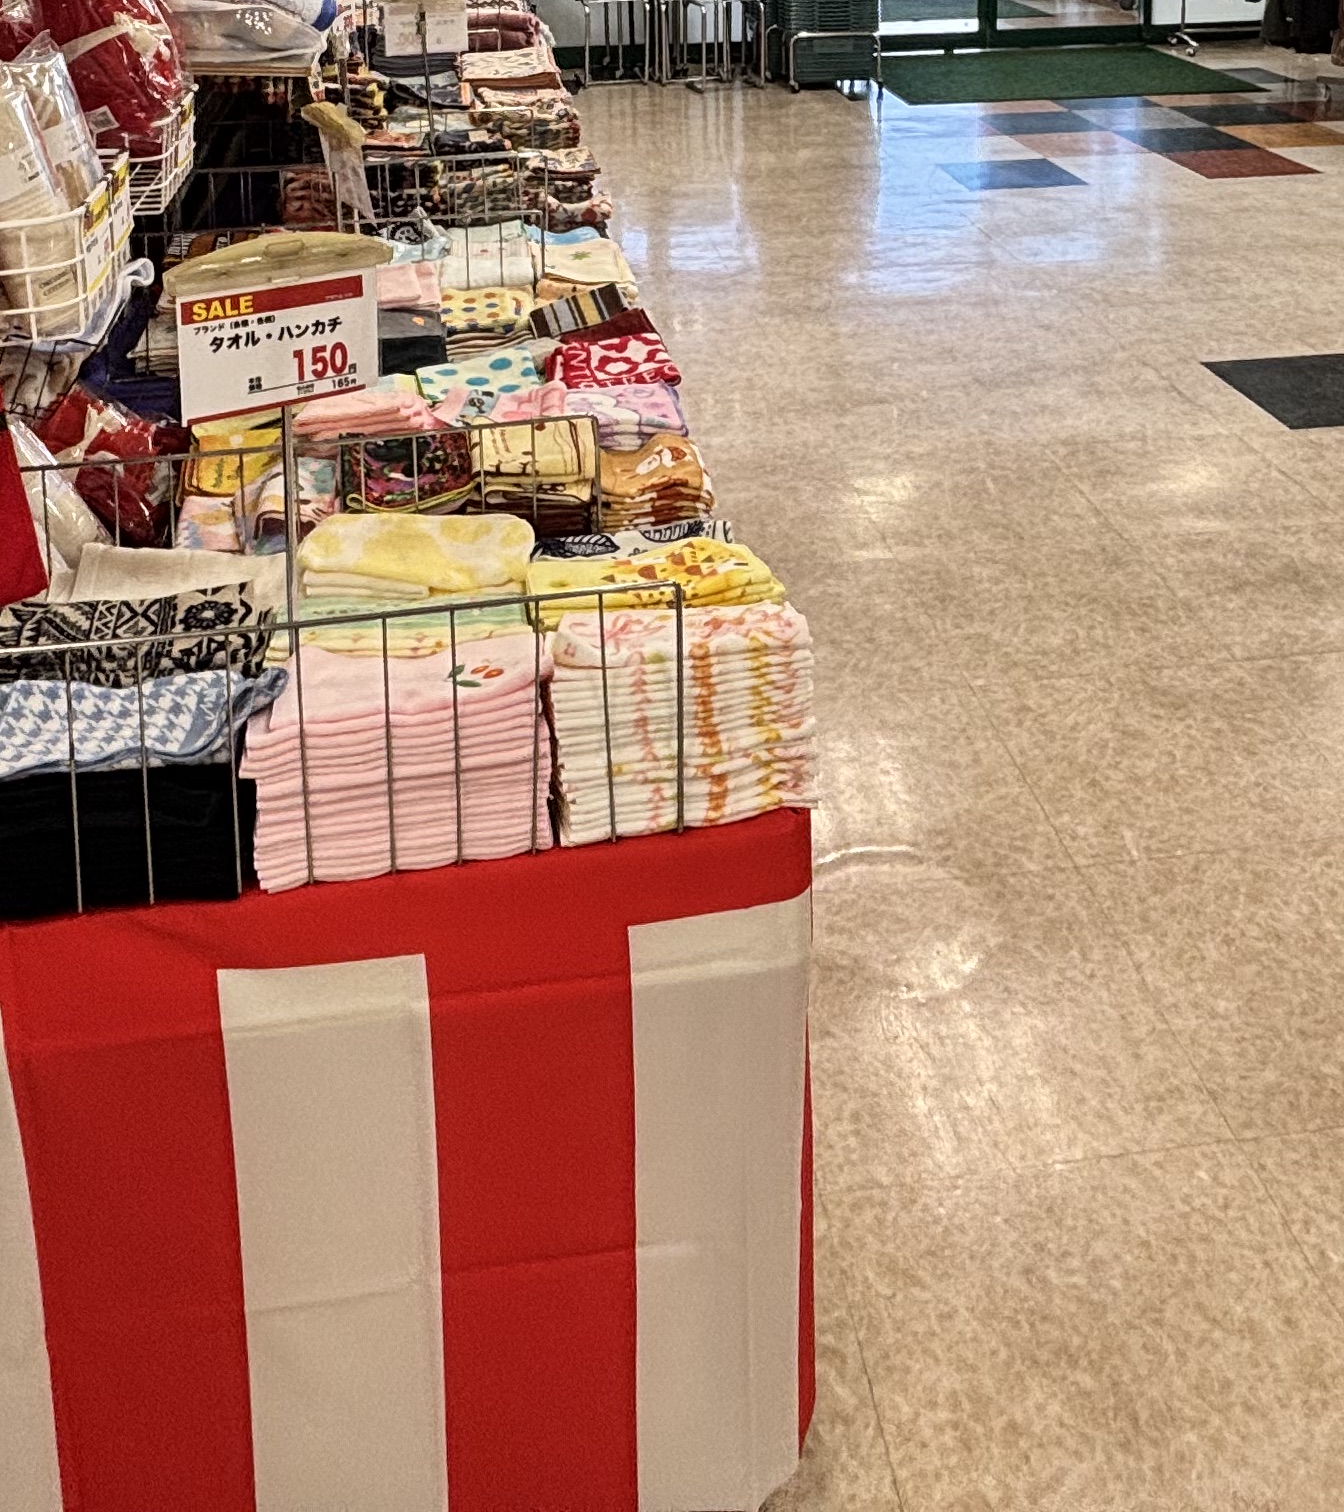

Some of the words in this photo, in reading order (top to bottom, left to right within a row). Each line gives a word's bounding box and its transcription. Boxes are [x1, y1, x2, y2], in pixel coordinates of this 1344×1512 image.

[192, 295, 254, 321] SALE
[210, 316, 342, 353] タオル・ハンカチ
[332, 377, 357, 389] 165円
